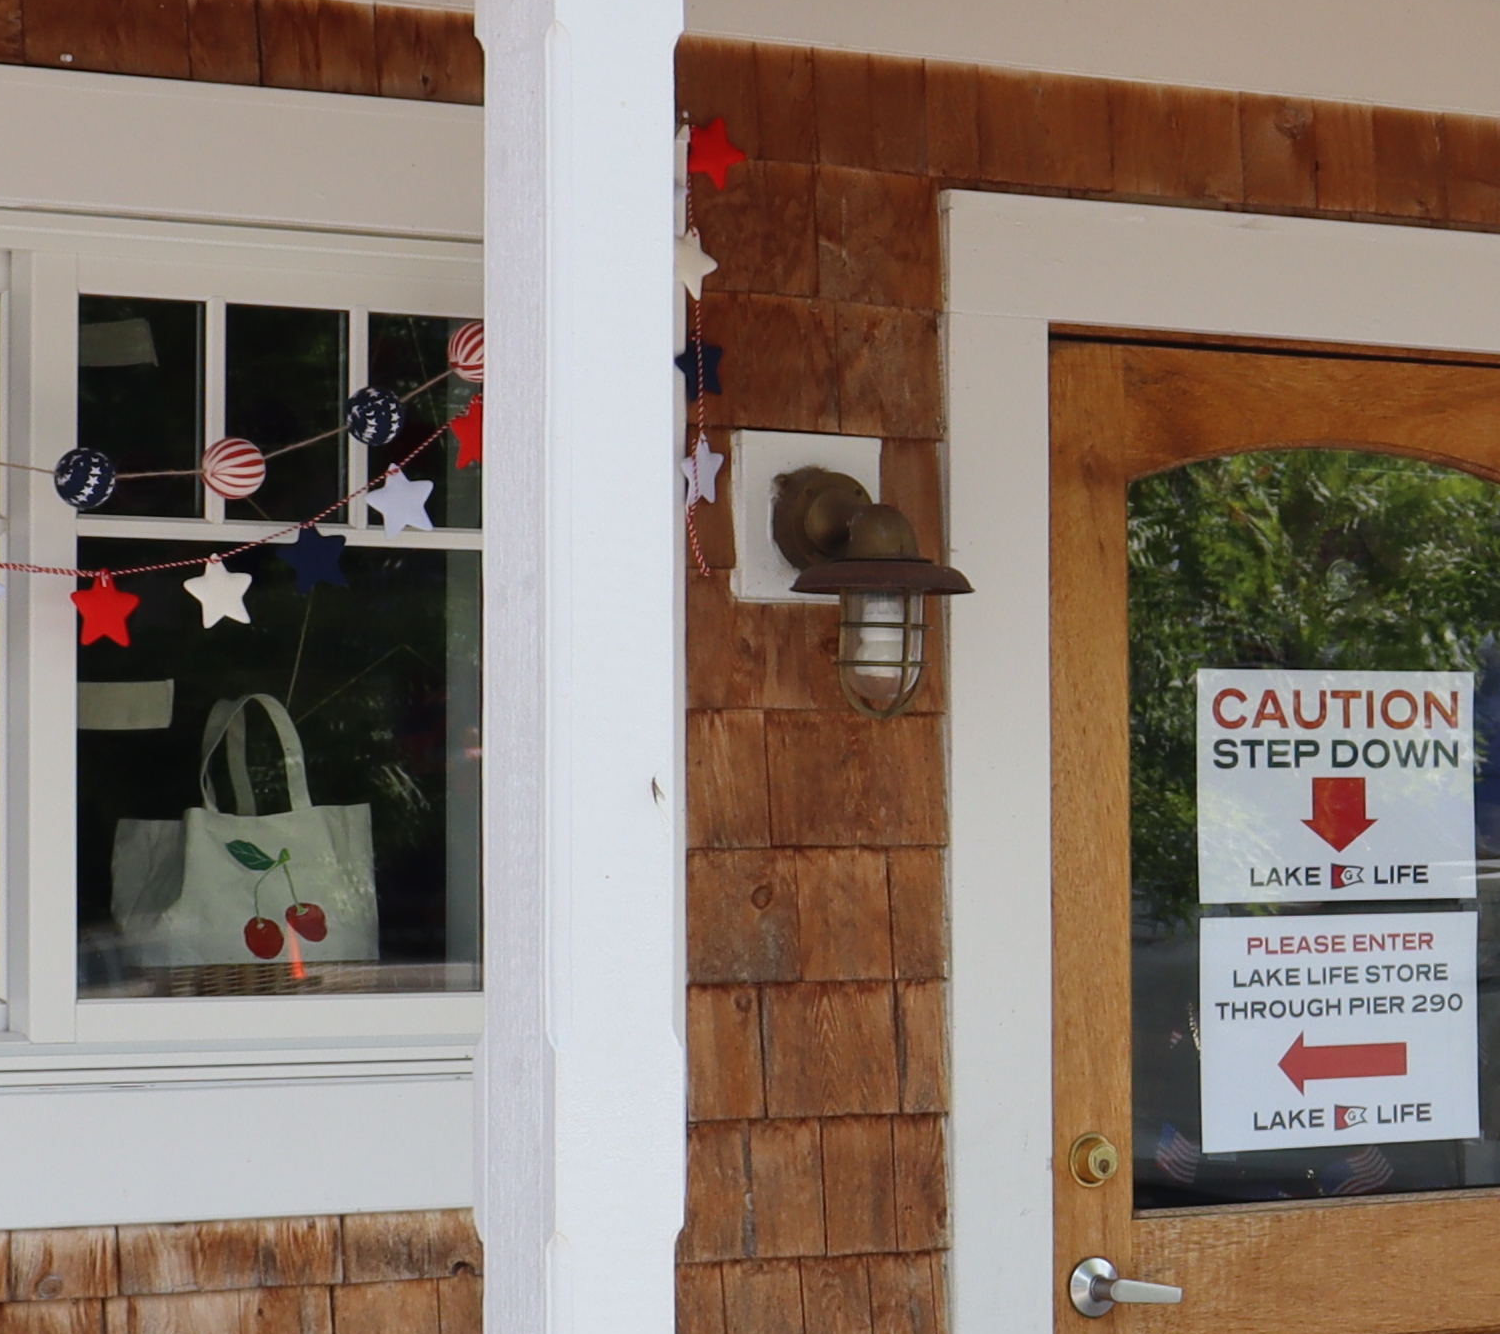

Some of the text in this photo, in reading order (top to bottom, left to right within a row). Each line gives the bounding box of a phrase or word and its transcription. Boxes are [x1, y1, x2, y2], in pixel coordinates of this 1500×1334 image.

[1212, 687, 1459, 730] CAUTION
[1213, 738, 1459, 769] STEP DOWN
[1250, 866, 1321, 887] LAKE
[1374, 865, 1429, 885] LIFE
[1247, 932, 1434, 955] PLEASE ENTER
[1233, 963, 1449, 988] LAKE LIFE STORE
[1214, 993, 1463, 1020] THROUGH PIER 290
[1253, 1108, 1325, 1131] LAKE
[1377, 1102, 1432, 1125] LIFE
